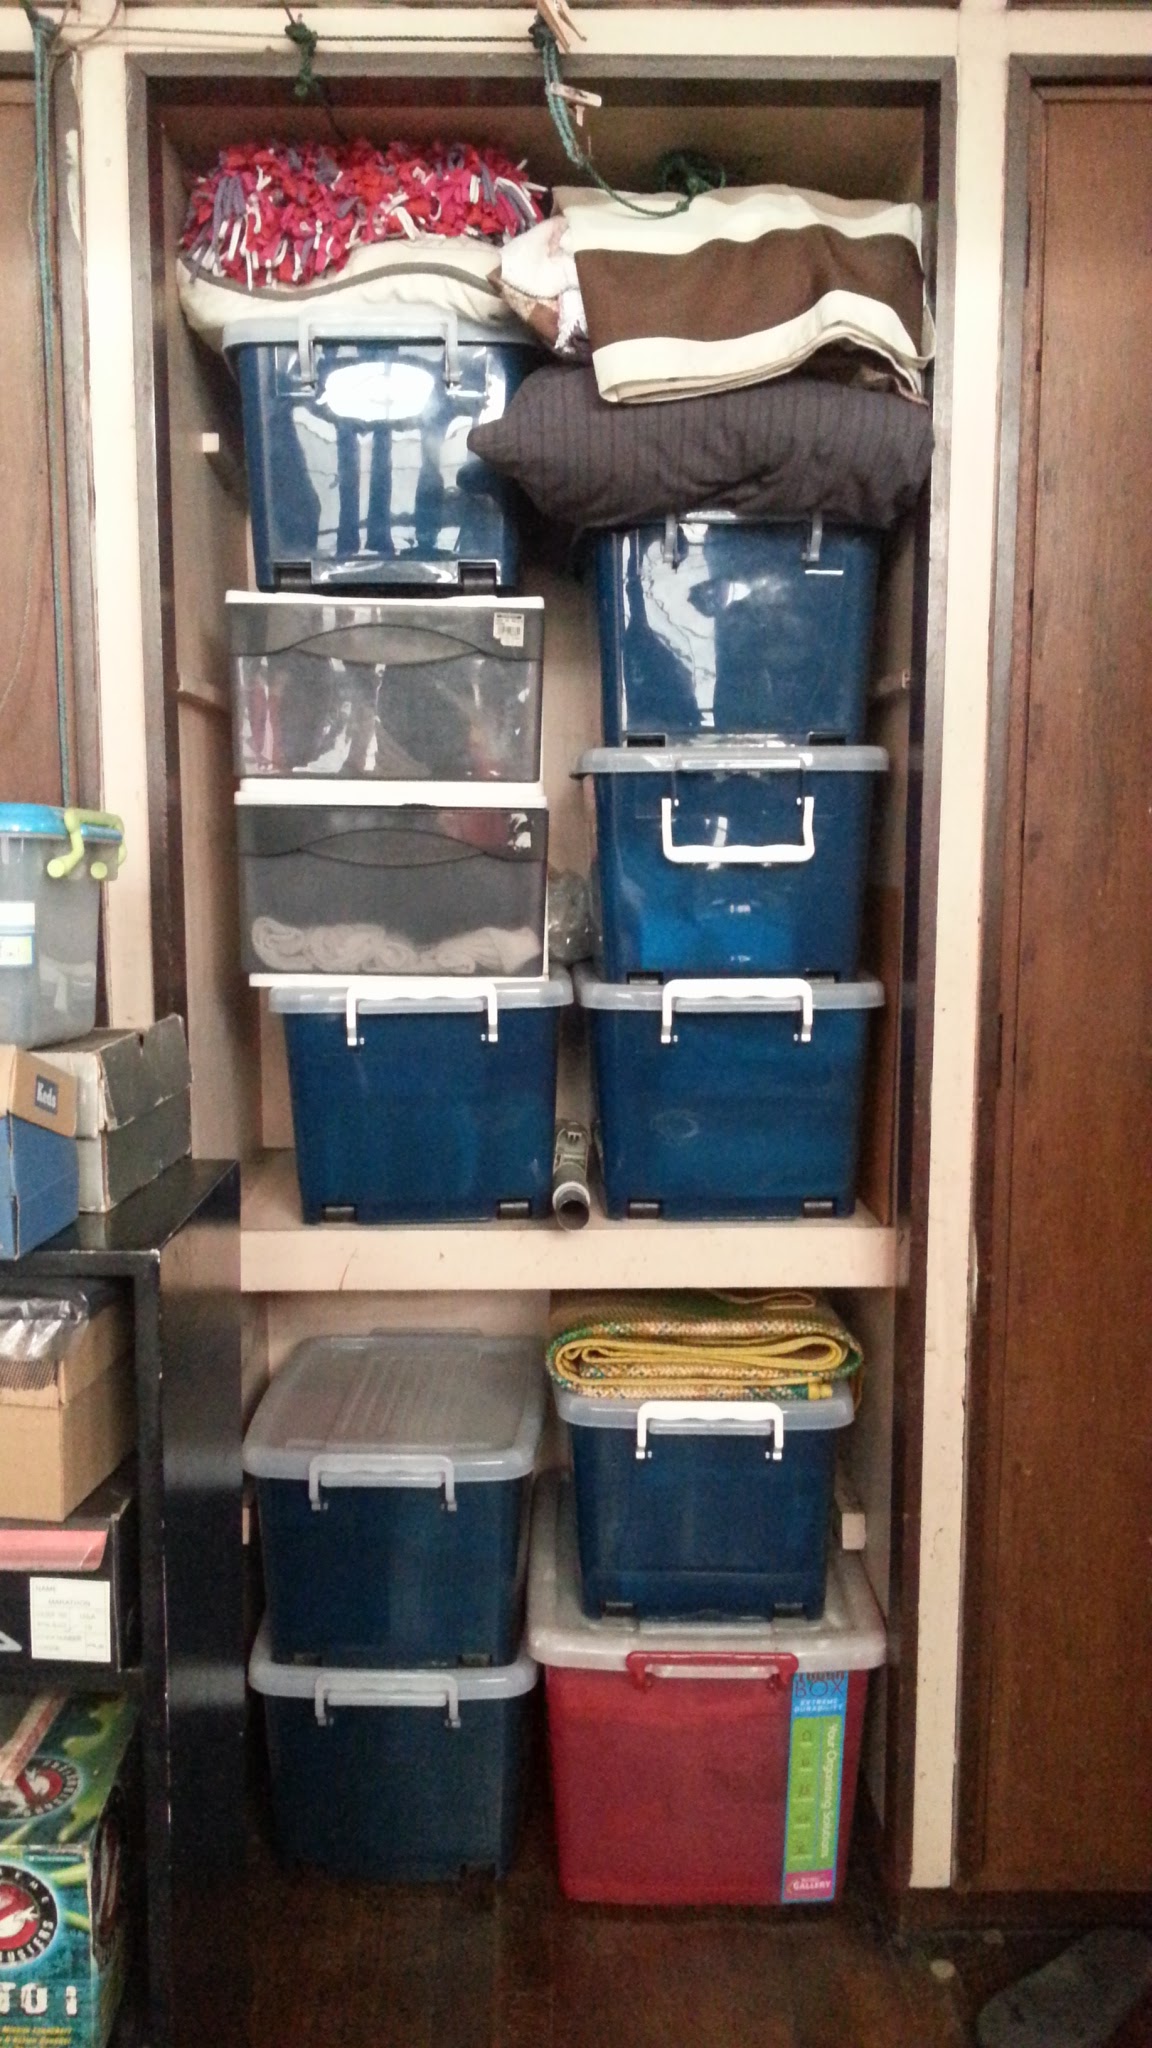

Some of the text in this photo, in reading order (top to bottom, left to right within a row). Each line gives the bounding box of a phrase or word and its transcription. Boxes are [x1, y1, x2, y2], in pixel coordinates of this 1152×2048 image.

[37, 1081, 56, 1108] Keds
[48, 1599, 90, 1607] MARATHON
[795, 1679, 844, 1698] BOX
[827, 1722, 838, 1748] Your
[793, 1880, 831, 1890] GALLERY
